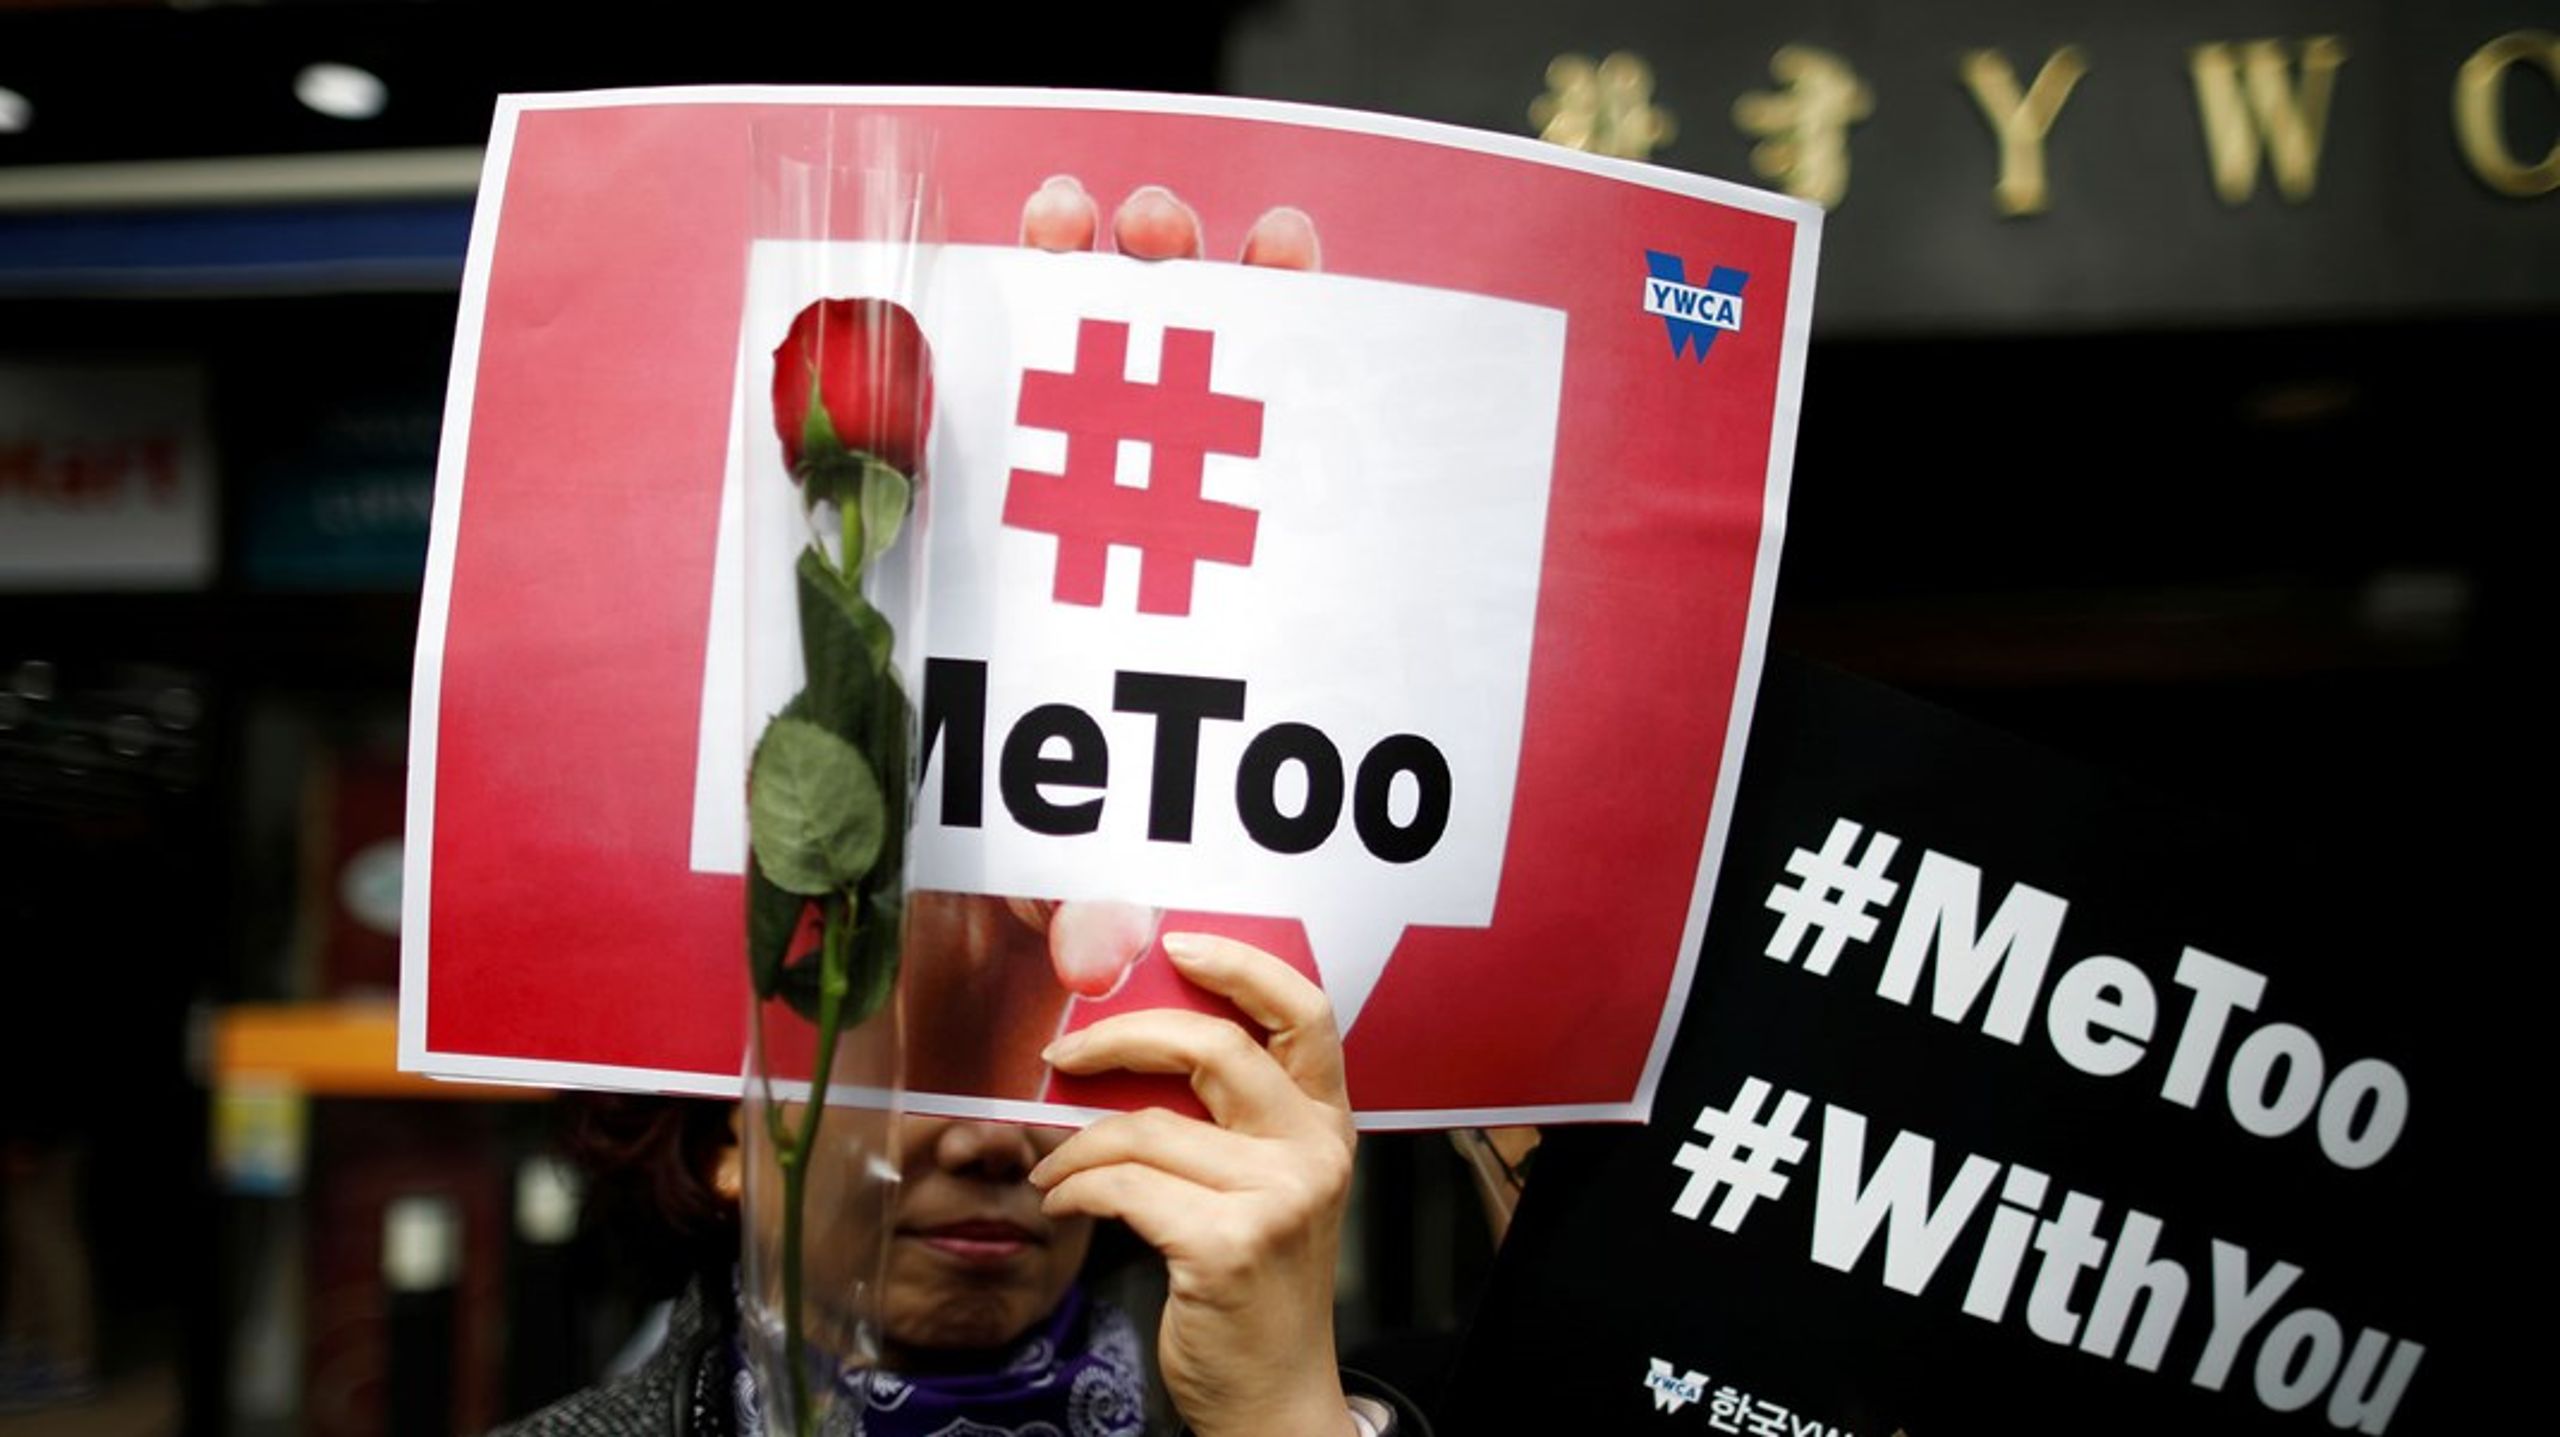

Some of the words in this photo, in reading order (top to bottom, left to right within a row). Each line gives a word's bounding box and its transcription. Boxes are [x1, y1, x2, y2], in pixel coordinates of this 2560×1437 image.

[1651, 282, 1736, 326] YWCA
[1001, 317, 1266, 618] #
[1763, 816, 2410, 1170] #MeToo
[1651, 1373, 1697, 1400] YWCA
[1671, 1074, 2426, 1437] #WithYou
